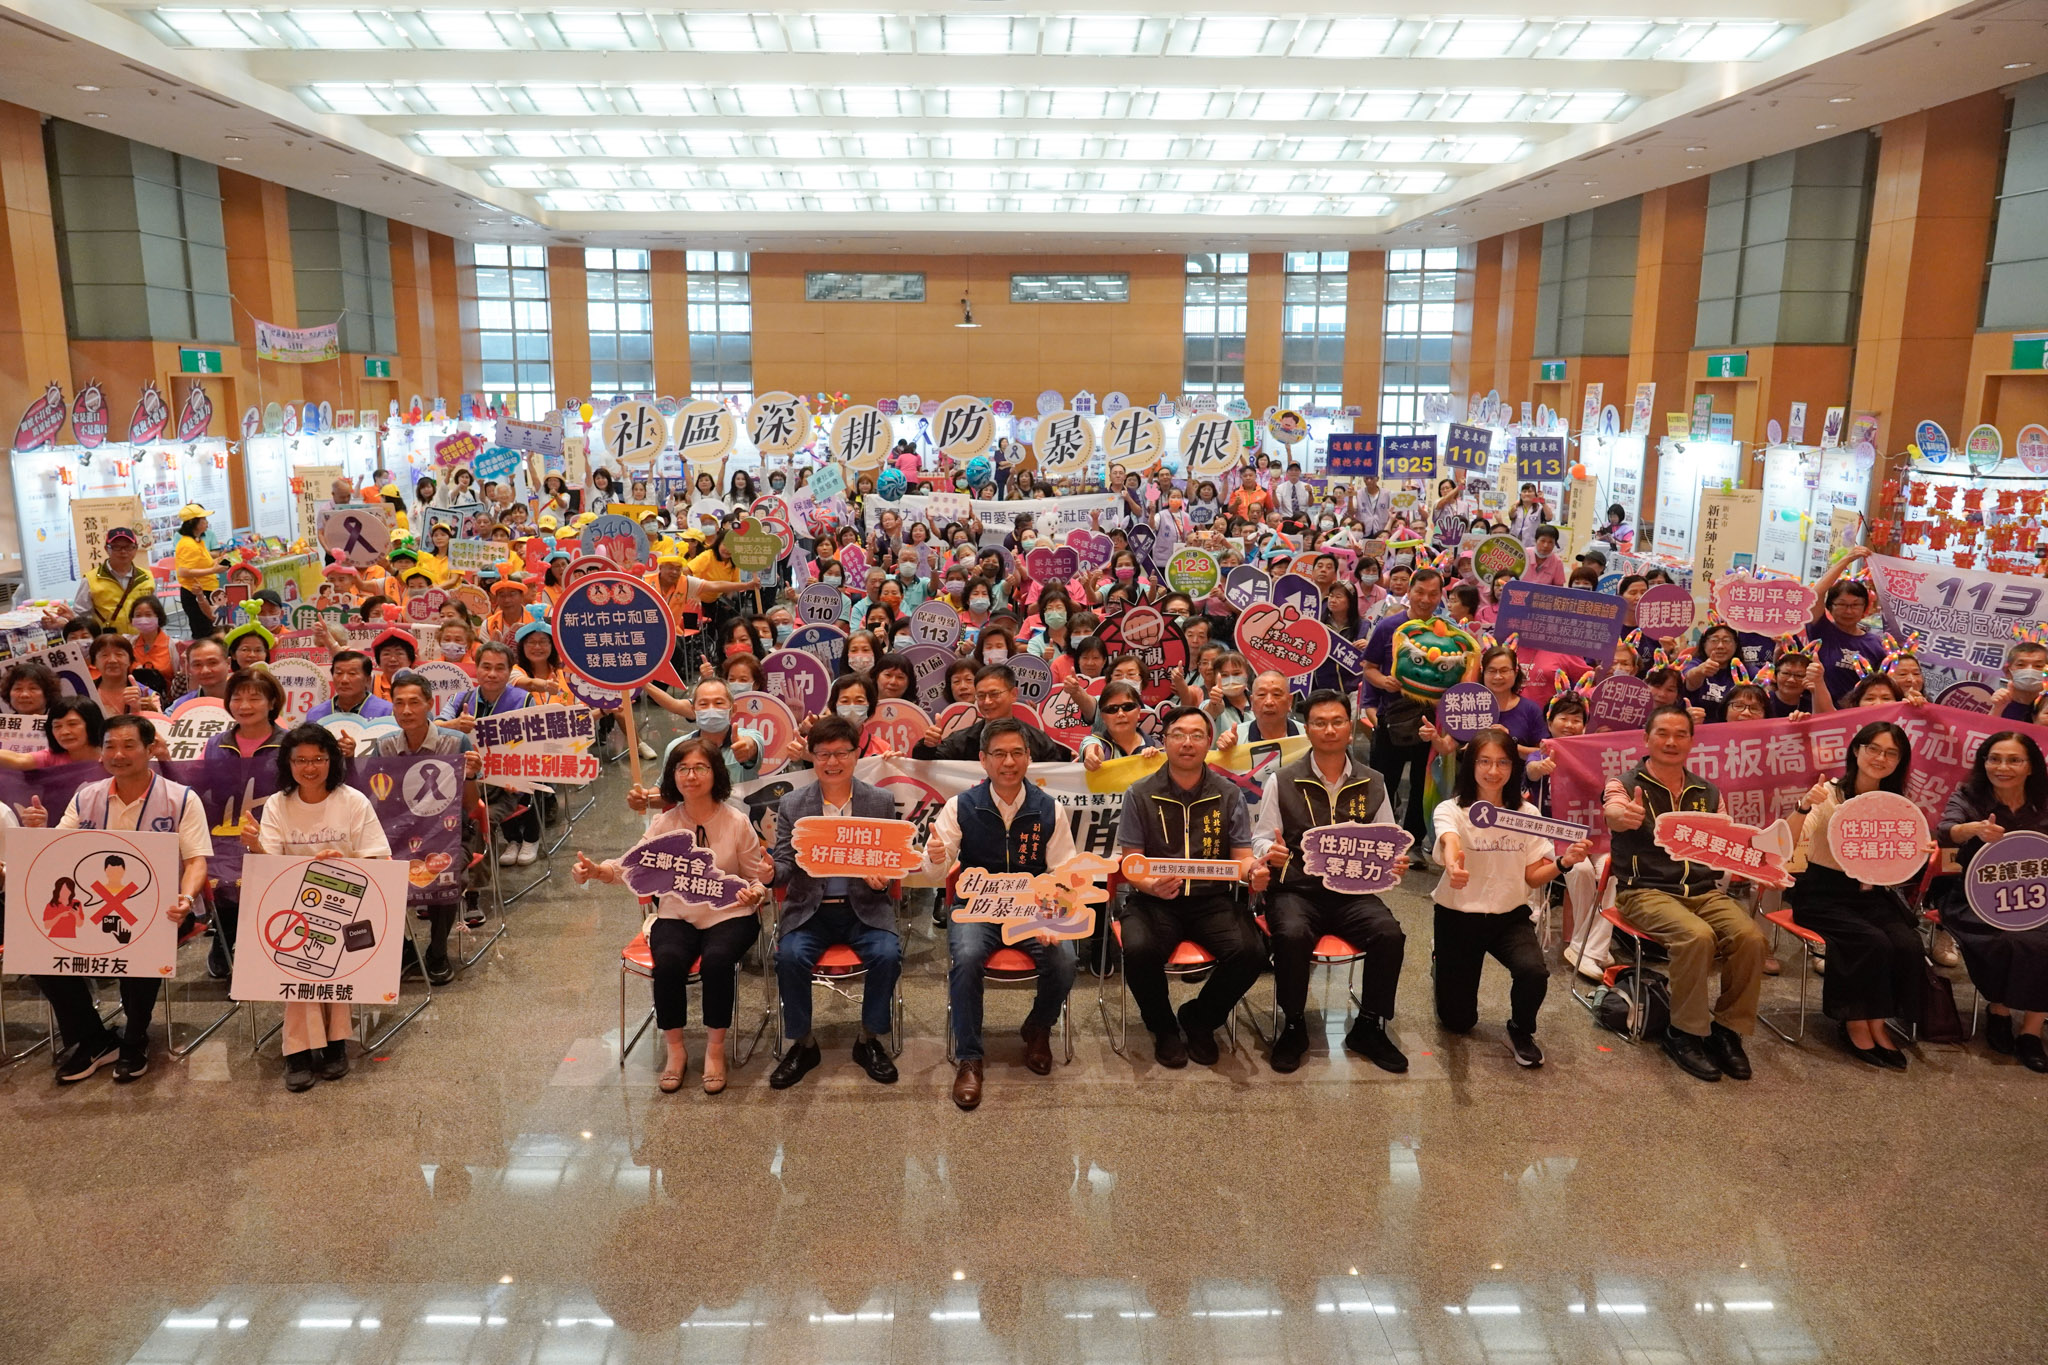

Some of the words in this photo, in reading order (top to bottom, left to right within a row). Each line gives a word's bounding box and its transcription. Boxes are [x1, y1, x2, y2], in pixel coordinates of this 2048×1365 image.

[612, 406, 653, 456] 社
[679, 409, 726, 450] 區
[753, 400, 799, 444] 深
[940, 405, 987, 447] 防
[841, 411, 882, 460] 耕
[1042, 414, 1083, 465] 暴
[1110, 411, 1153, 461] 生
[1185, 420, 1232, 466] 根
[1388, 440, 1432, 451] 安心專線
[1454, 428, 1488, 444] 緊急專線
[1449, 445, 1486, 467] 110
[1520, 442, 1559, 452] 保護專線
[1386, 457, 1433, 473] 1925
[1519, 459, 1561, 475] 113
[590, 521, 633, 542] 540
[1035, 558, 1071, 566] 家是港口
[1174, 559, 1210, 572] 123
[1491, 548, 1515, 567] 0800
[804, 594, 839, 607] 求救專線
[1729, 585, 1803, 605] 性別平等
[1937, 576, 2043, 617] 113
[411, 601, 427, 619] 聽
[563, 609, 659, 628] 新北市中和區
[807, 607, 832, 620] 110
[917, 611, 957, 628] 保護專線
[1639, 601, 1692, 628] 讓愛更美麗
[1728, 605, 1802, 625] 幸福升等
[583, 631, 646, 648] 莒東社區
[919, 625, 949, 643] 113
[1268, 628, 1317, 655] 性別友善
[585, 651, 648, 668] 發展協會
[1250, 636, 1313, 667] 從你我做起
[1445, 692, 1491, 712] 紫絲帶
[1601, 681, 1651, 706] 性別平等
[1445, 713, 1493, 730] 守護愛
[1594, 701, 1646, 726] 向上提升
[475, 708, 594, 748] 拒絕性騷擾
[875, 724, 910, 753] 113
[483, 754, 599, 779] 拒絕性別暴力
[836, 826, 881, 846] 別怕!
[1545, 825, 1584, 840] 防暴生根
[1842, 819, 1916, 839] 性別平等
[1319, 834, 1396, 860] 性別平等
[1673, 823, 1763, 868] 家暴要通報
[1842, 839, 1916, 859] 幸福升等
[639, 850, 706, 877] 左鄰右舍
[811, 845, 902, 868] 好厝邊都在
[1325, 858, 1383, 881] 零暴力
[673, 875, 724, 898] 來相挺
[963, 873, 1028, 895] 社區深耕
[970, 897, 1037, 917] 防暴生根
[1995, 884, 2046, 913] 113
[53, 956, 129, 974] 不刪好友
[279, 983, 354, 1000] 不刪帳號
